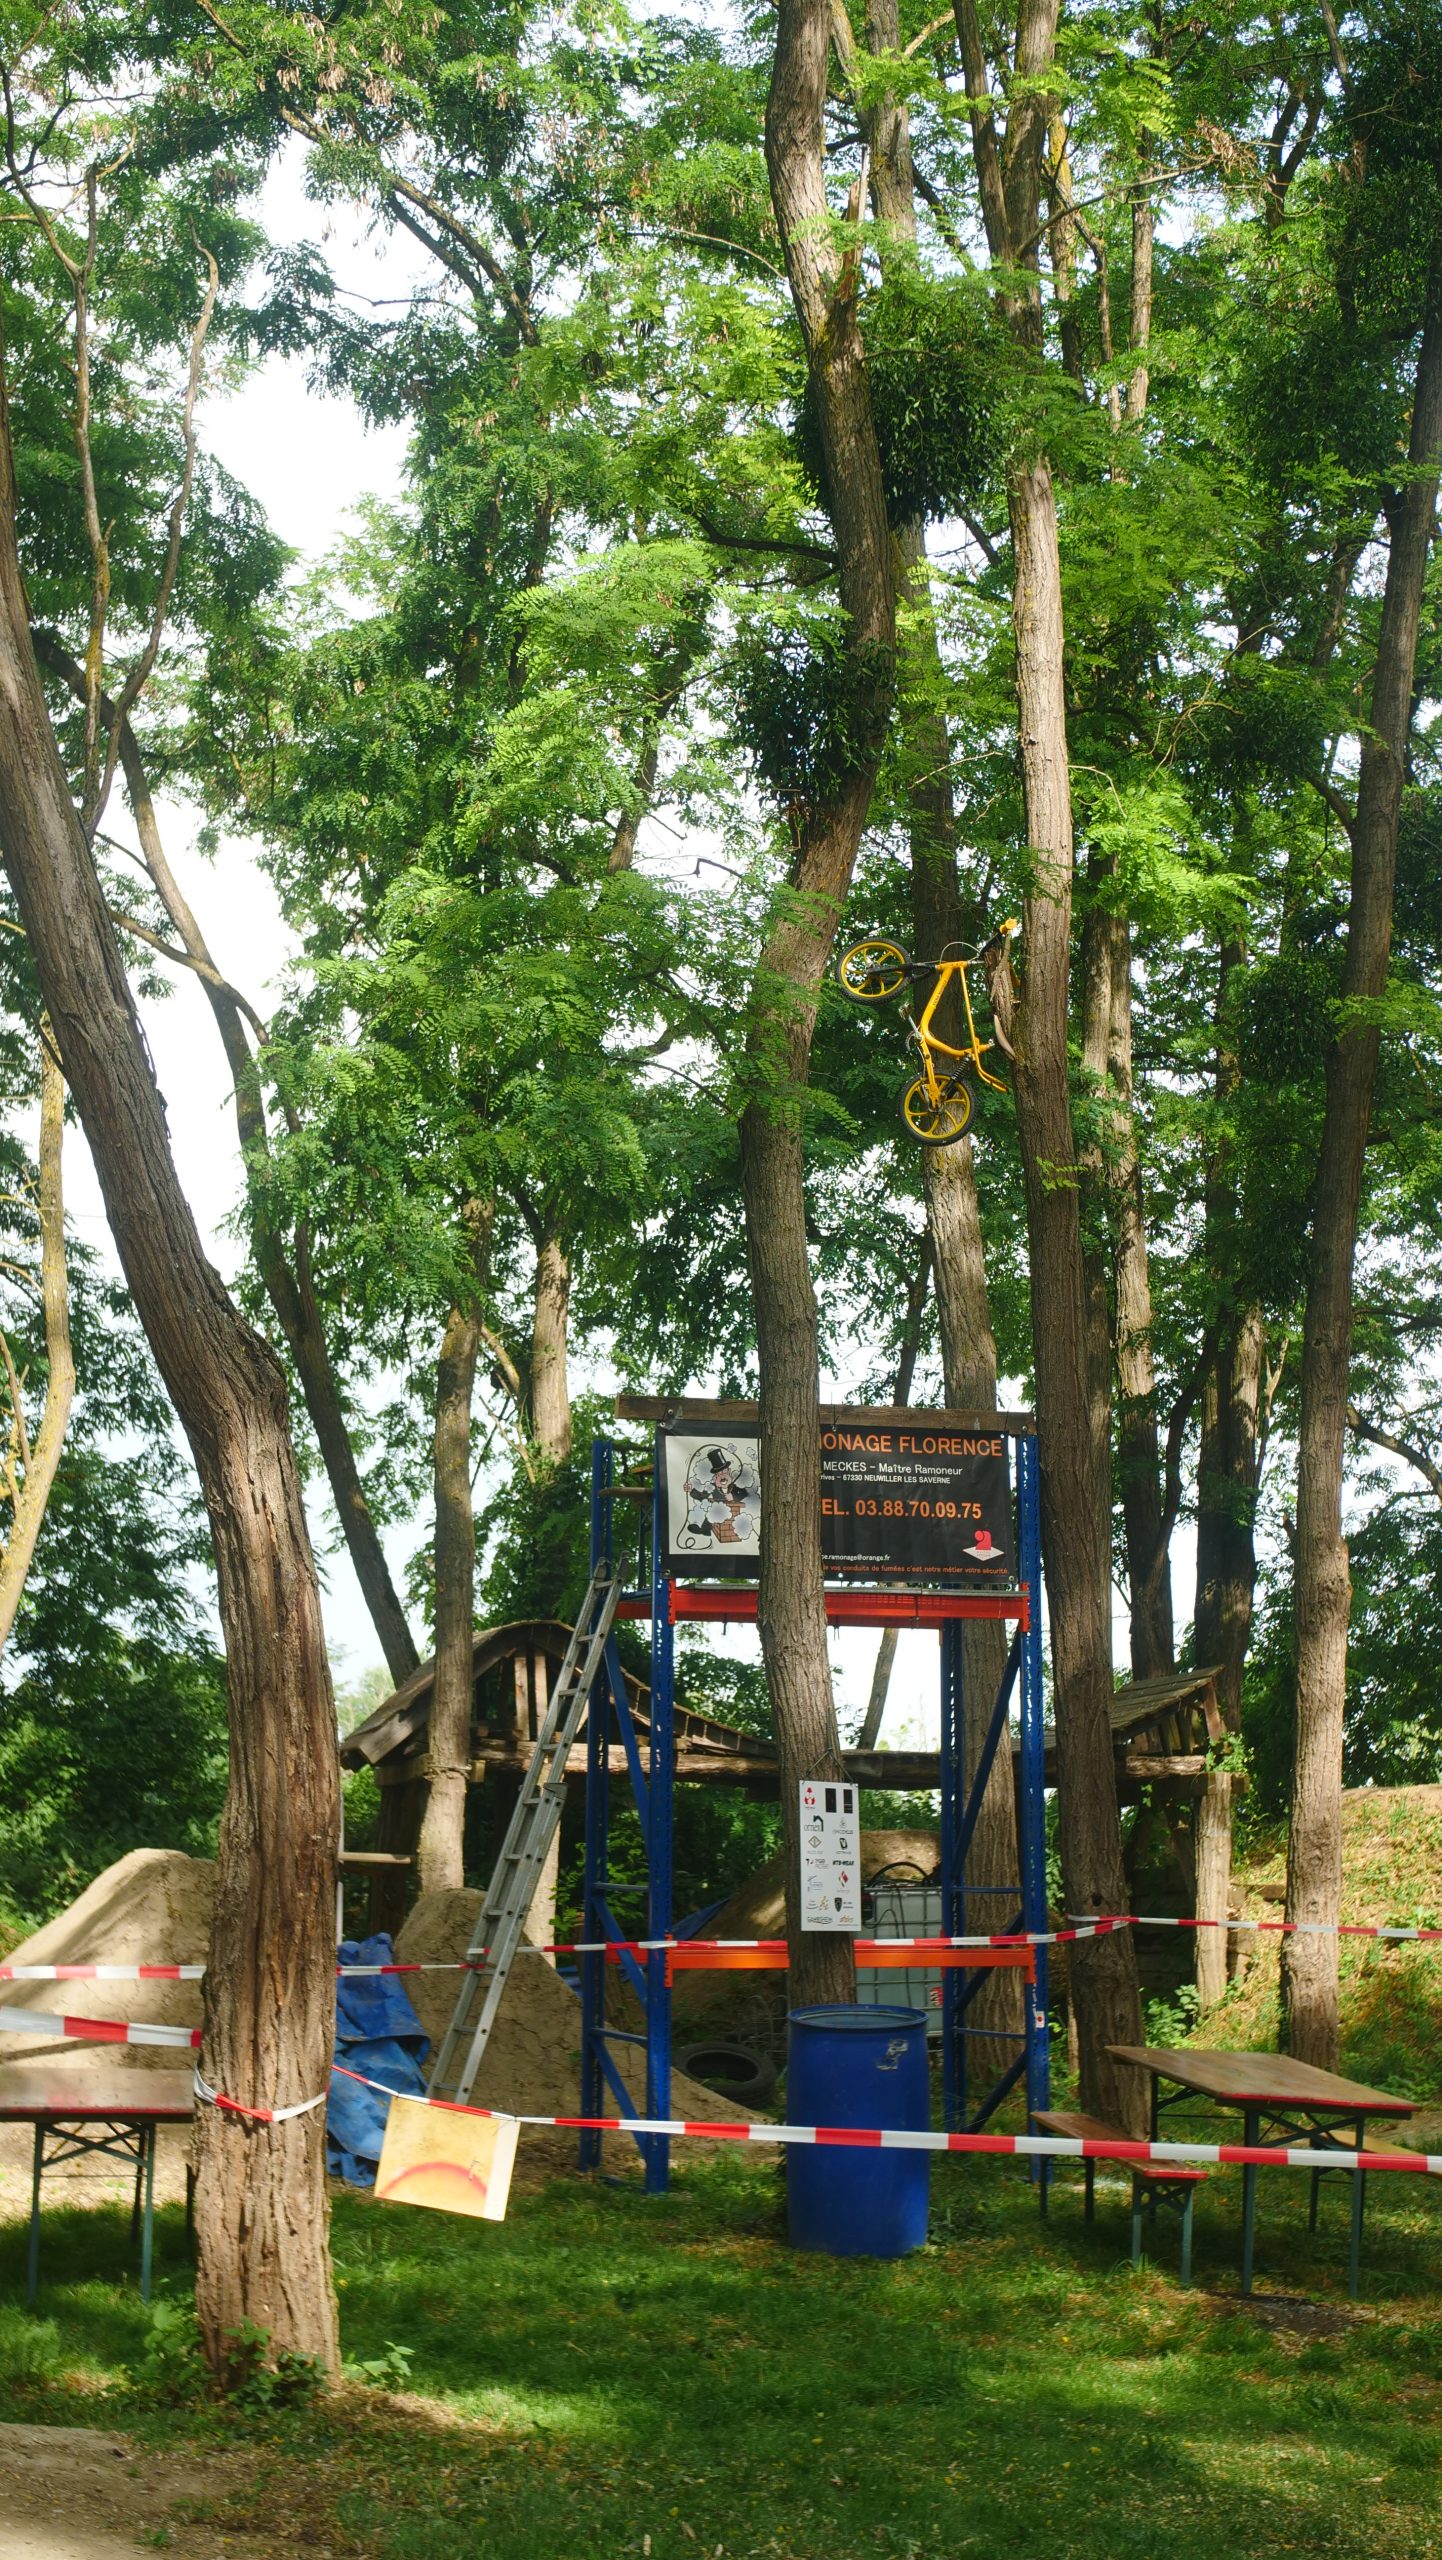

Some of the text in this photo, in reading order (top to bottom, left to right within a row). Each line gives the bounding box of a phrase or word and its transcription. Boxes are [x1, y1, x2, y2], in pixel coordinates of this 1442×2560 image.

[820, 1433, 1002, 1457] ONAGE FLORENCE
[823, 1461, 867, 1472] MECKES
[878, 1462, 912, 1474] Maître
[914, 1464, 963, 1476] Ramoneur
[842, 1474, 863, 1482] 67330
[864, 1474, 903, 1483] NEUWILLER
[903, 1475, 917, 1484] LES
[918, 1476, 951, 1484] SAVERNE
[822, 1499, 982, 1519] EL. 03.88.70.09.75
[842, 1564, 869, 1572] conduits
[871, 1564, 880, 1572] de
